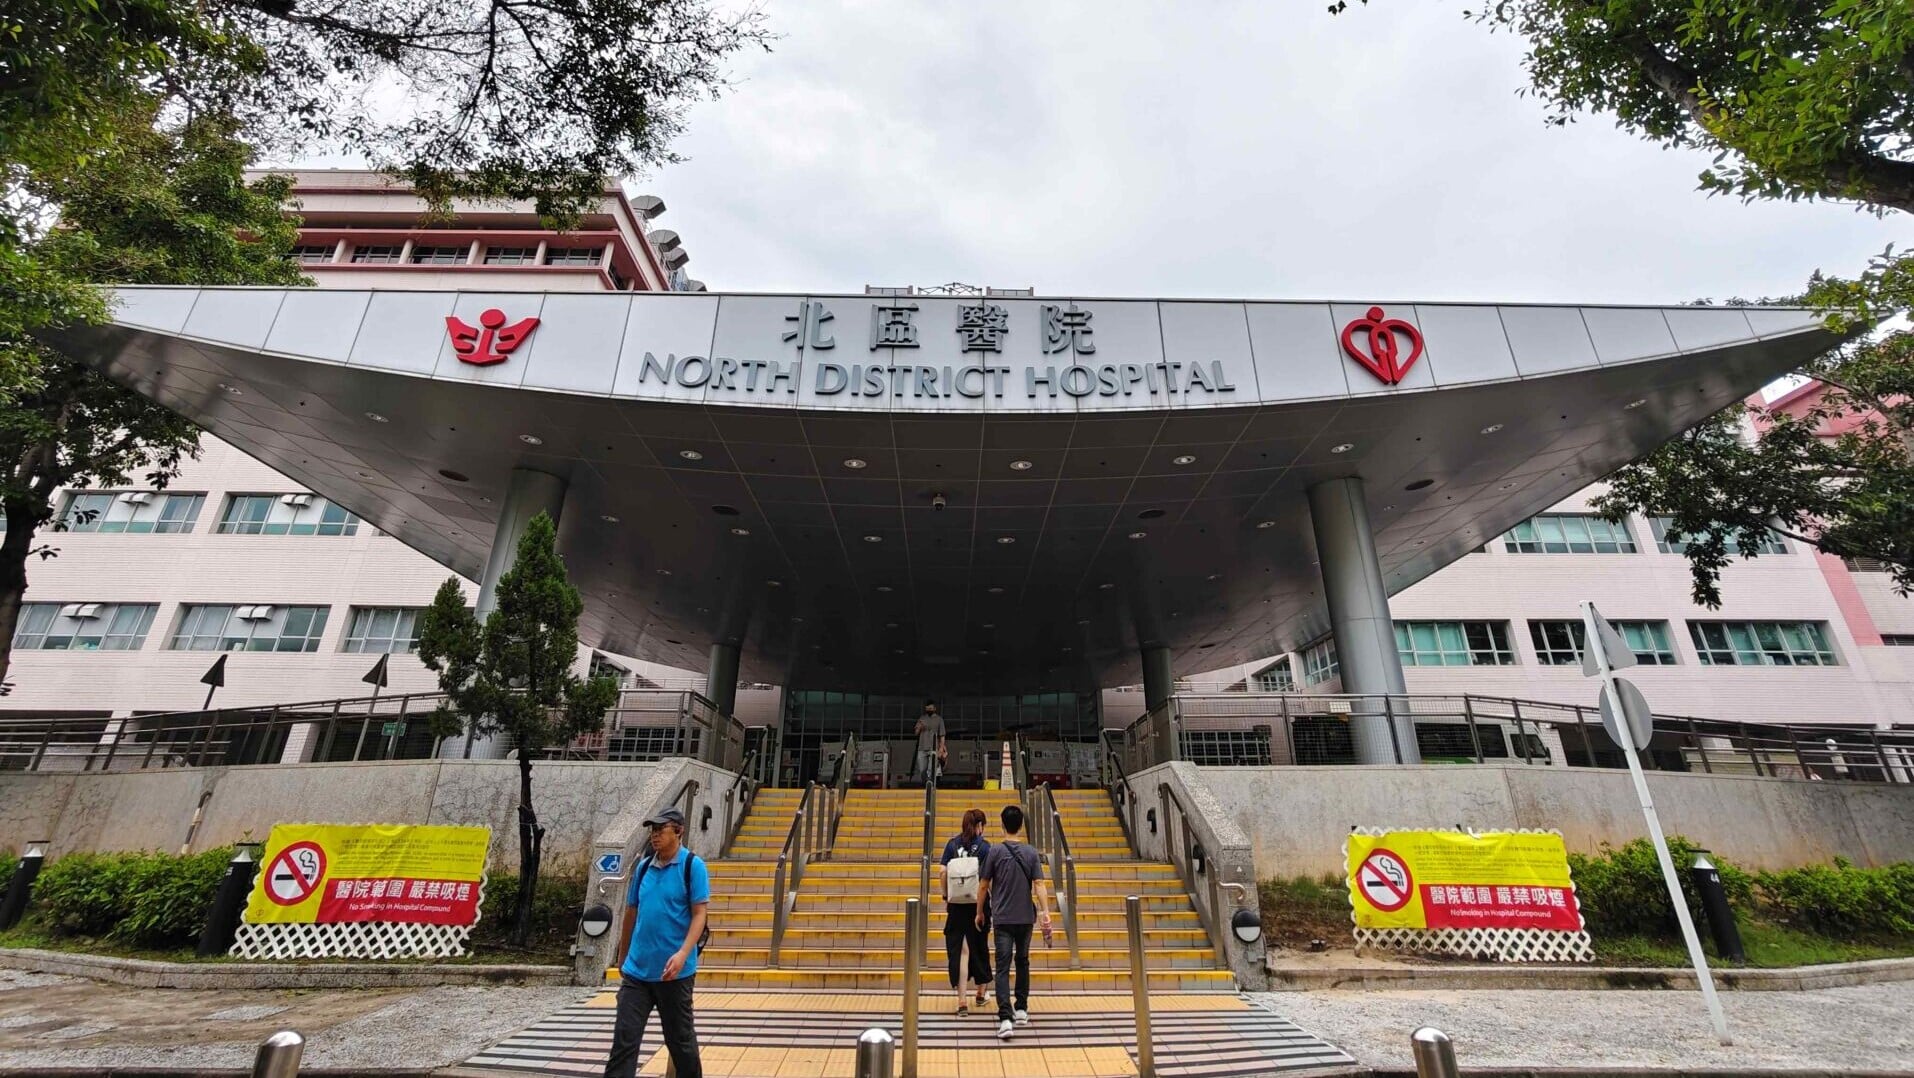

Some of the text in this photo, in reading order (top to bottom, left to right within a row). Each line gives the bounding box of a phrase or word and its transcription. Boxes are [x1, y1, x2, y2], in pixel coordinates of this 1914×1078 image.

[781, 300, 1097, 355] 北區醫院
[639, 352, 1235, 398] NORTH DISTRICT HOSPITAL
[335, 880, 472, 902] 醫院範圍 嚴禁吸煙
[1430, 887, 1566, 907] 醫院範圍 嚴禁吸煙
[394, 904, 420, 912] Hospital
[1491, 910, 1515, 918] Hospital
